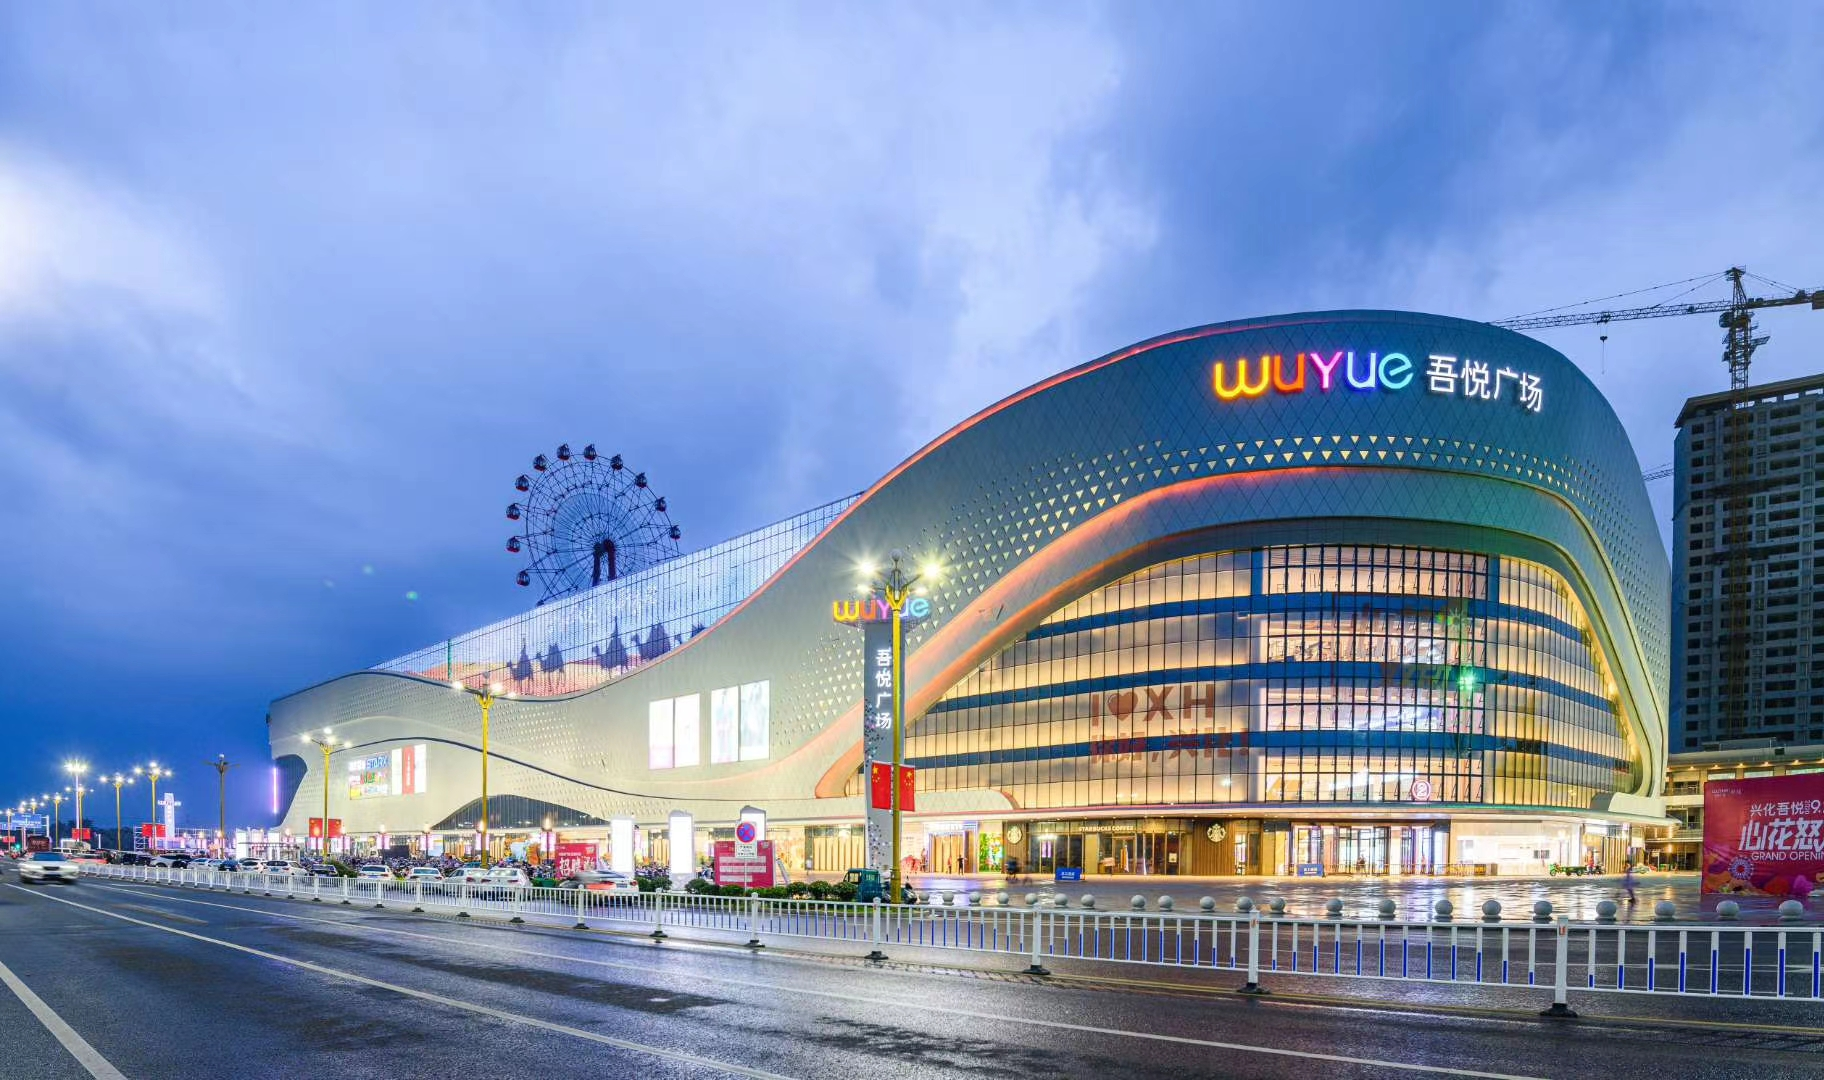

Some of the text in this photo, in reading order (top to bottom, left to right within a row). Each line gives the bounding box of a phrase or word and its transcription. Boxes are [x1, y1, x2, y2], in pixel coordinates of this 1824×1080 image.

[1426, 354, 1543, 413] 吾悦广场
[875, 649, 892, 730] 吾悦广场
[1143, 684, 1214, 721] XH
[1751, 802, 1804, 816] 兴化吾悦
[1752, 852, 1786, 861] GRAND
